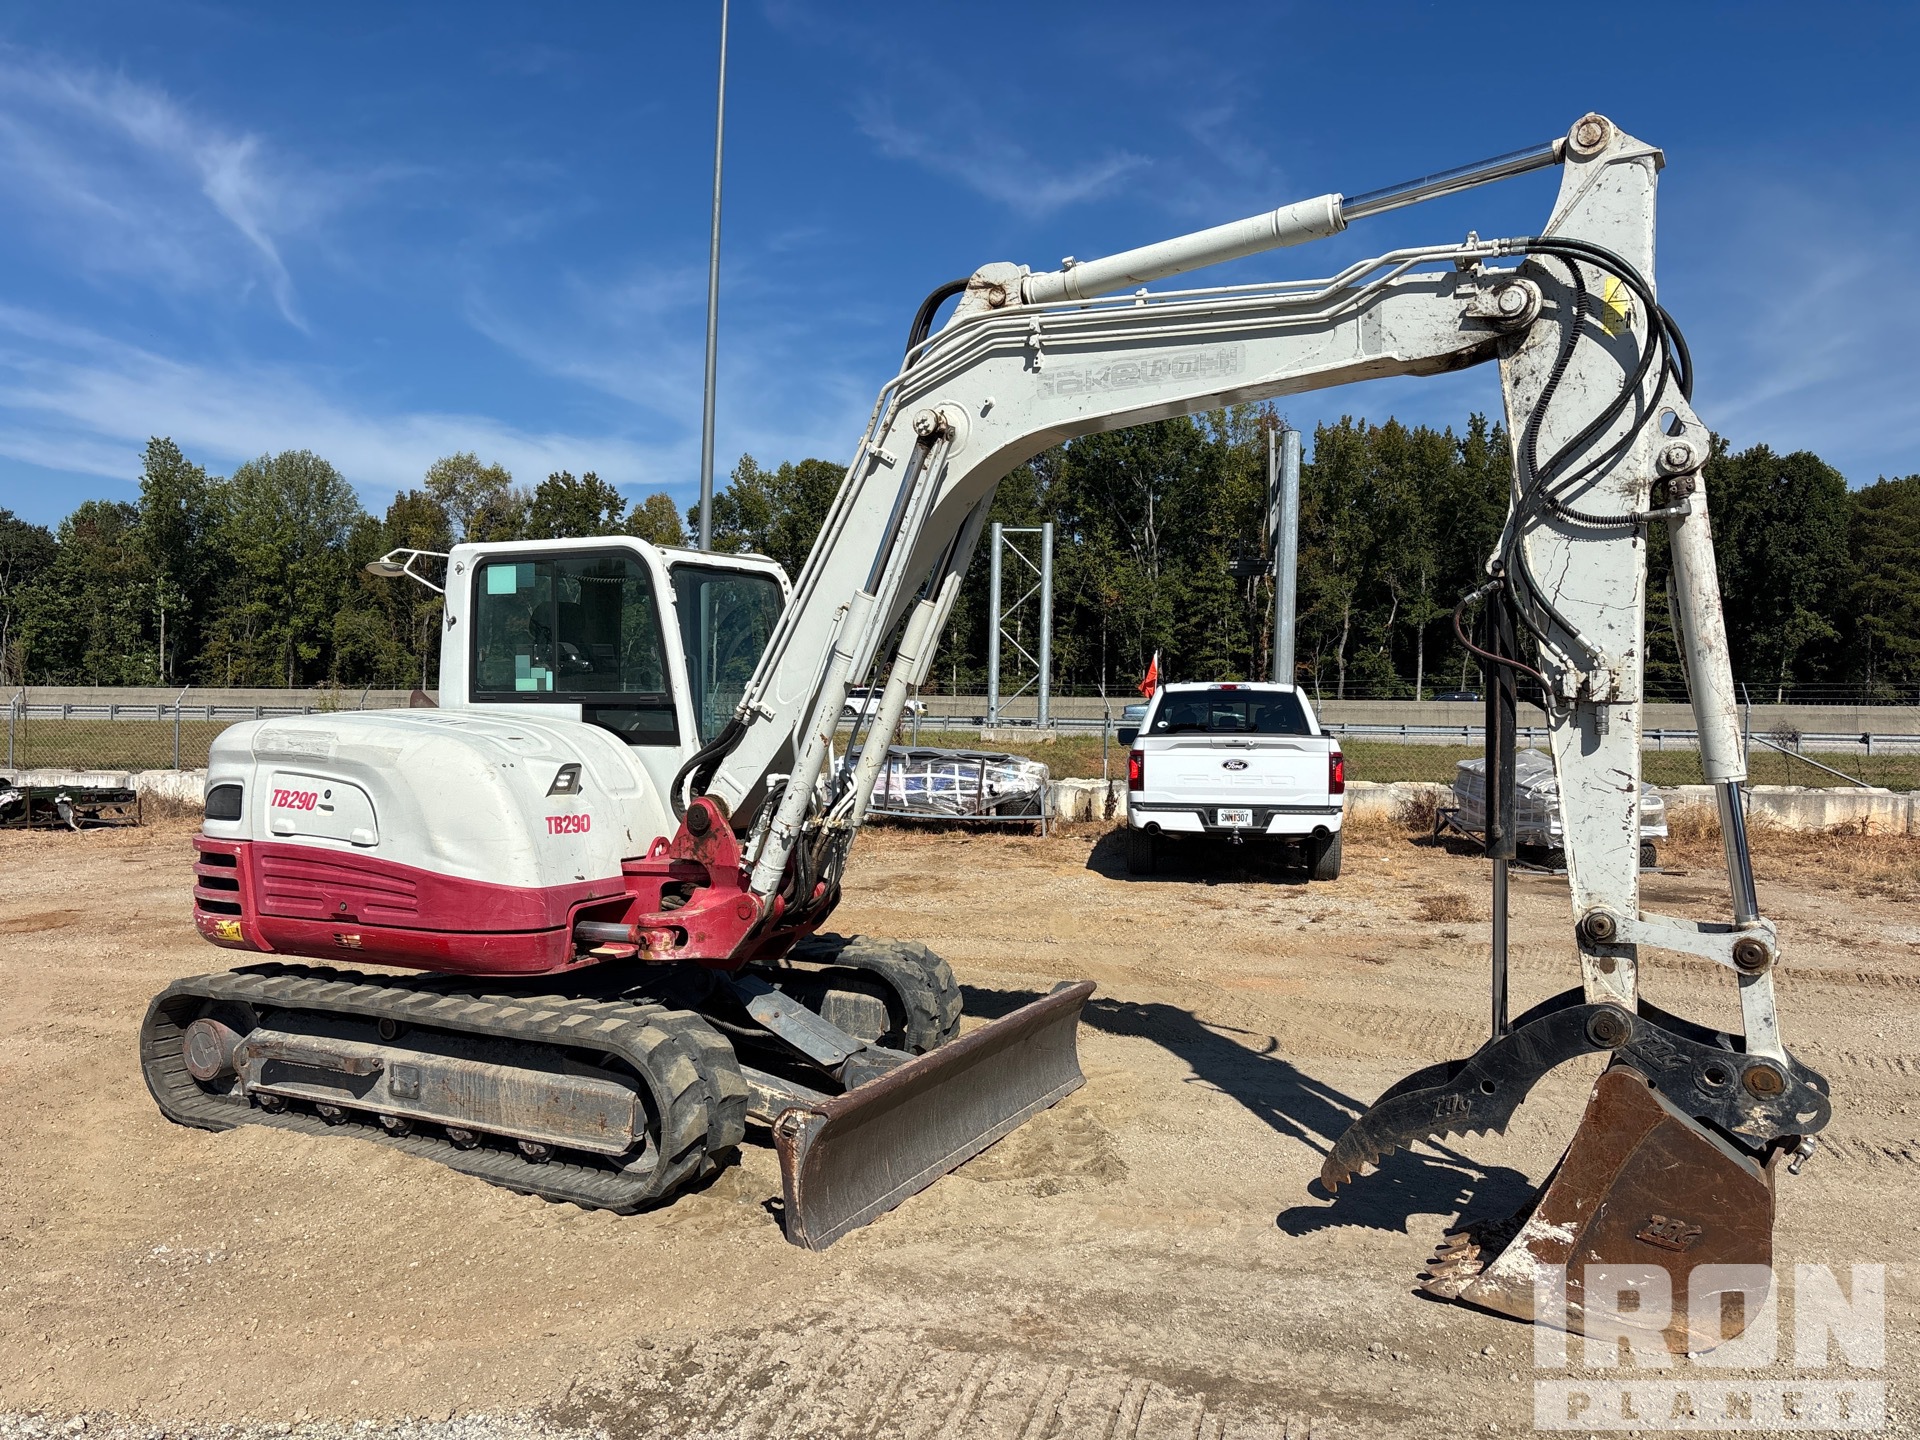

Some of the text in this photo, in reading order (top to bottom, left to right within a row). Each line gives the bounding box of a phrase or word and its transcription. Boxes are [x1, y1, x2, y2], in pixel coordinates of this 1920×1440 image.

[1224, 759, 1248, 771] Ford
[1178, 774, 1295, 787] F-150
[271, 788, 318, 811] TB290
[545, 814, 591, 835] TB290
